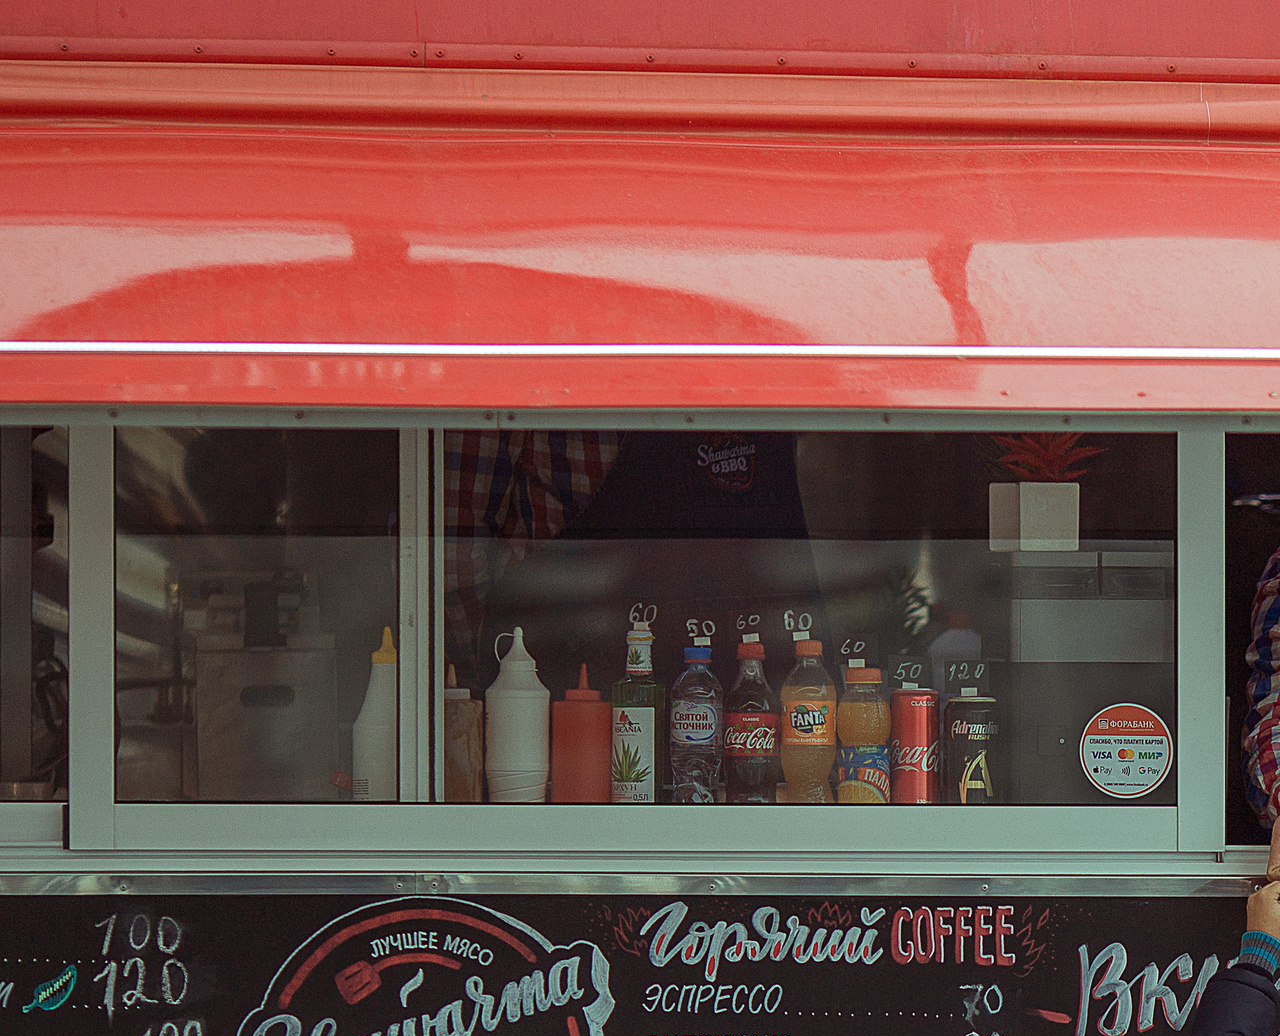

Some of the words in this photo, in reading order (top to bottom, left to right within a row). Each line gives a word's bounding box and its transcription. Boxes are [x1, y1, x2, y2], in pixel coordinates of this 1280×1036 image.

[629, 603, 657, 624] 60
[736, 614, 760, 630] 60
[784, 610, 813, 631] 60
[686, 618, 716, 637] 50
[841, 639, 865, 655] 60
[894, 662, 922, 680] 50
[949, 663, 985, 682] 120
[790, 710, 826, 727] FANTA
[1109, 720, 1155, 728] ФОРАБАНК
[1091, 751, 1113, 760] VISA
[1138, 751, 1163, 760] МИР
[1099, 766, 1113, 776] Pay
[1147, 766, 1161, 776] Pay
[94, 913, 182, 955] 100
[639, 901, 887, 982] Горячий
[890, 905, 1017, 966] COFFEE
[370, 931, 438, 958] ЛУЧШЕЕ
[443, 934, 494, 966] МЯСО
[93, 956, 188, 1022] 120
[641, 983, 784, 1014] ЭСПРЕССО
[959, 983, 1004, 1026] 70
